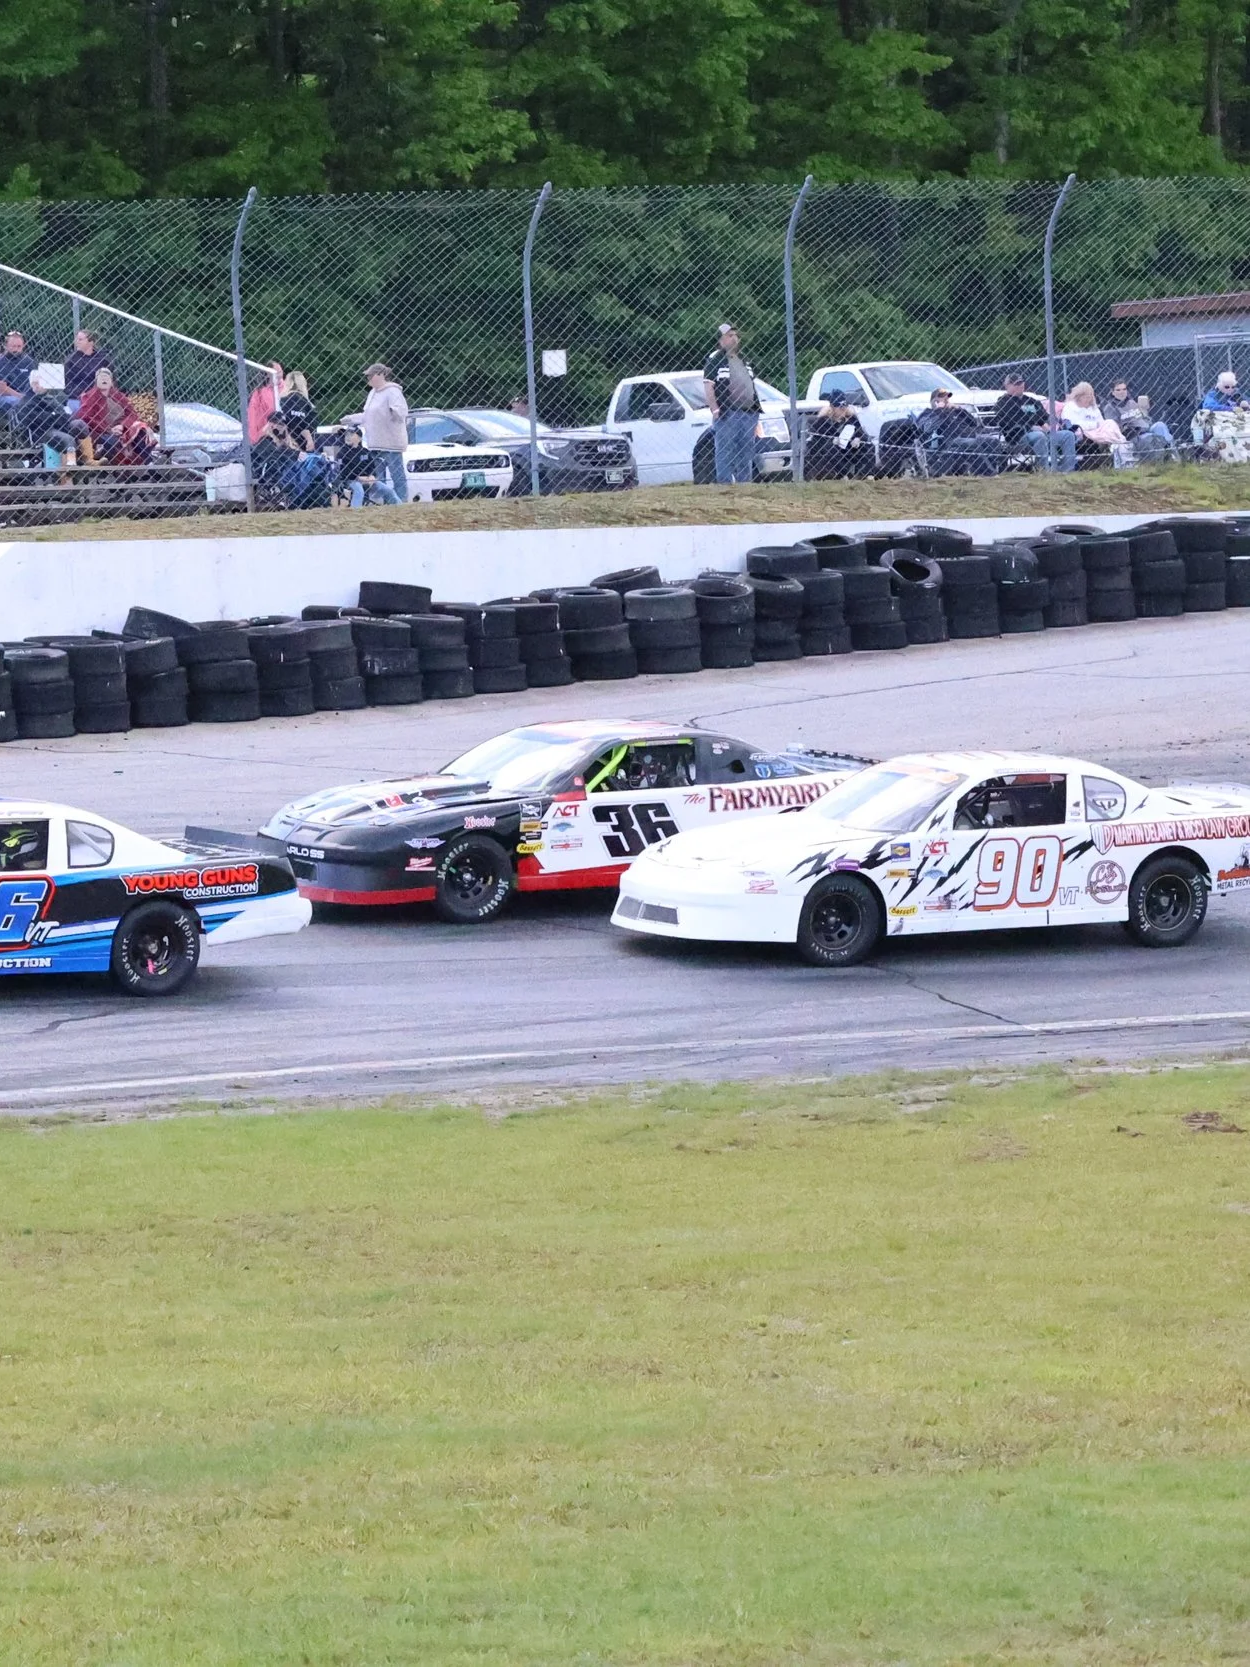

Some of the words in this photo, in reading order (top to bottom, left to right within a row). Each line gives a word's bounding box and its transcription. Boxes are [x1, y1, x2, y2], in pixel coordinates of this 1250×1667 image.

[553, 805, 580, 817] ACT
[682, 793, 705, 805] The
[708, 781, 831, 813] FARMYARD
[591, 802, 680, 857] 36
[1114, 823, 1145, 847] MARTIN
[1204, 817, 1227, 840] LAW
[309, 849, 325, 859] SS
[121, 870, 199, 893] YOUNG
[202, 864, 259, 886] GUNS
[973, 835, 1064, 911] 90
[1216, 880, 1234, 890] METAL
[1235, 877, 1250, 887] RECY
[184, 883, 257, 898] CONSTRUCTION
[174, 915, 195, 962] Hoosier
